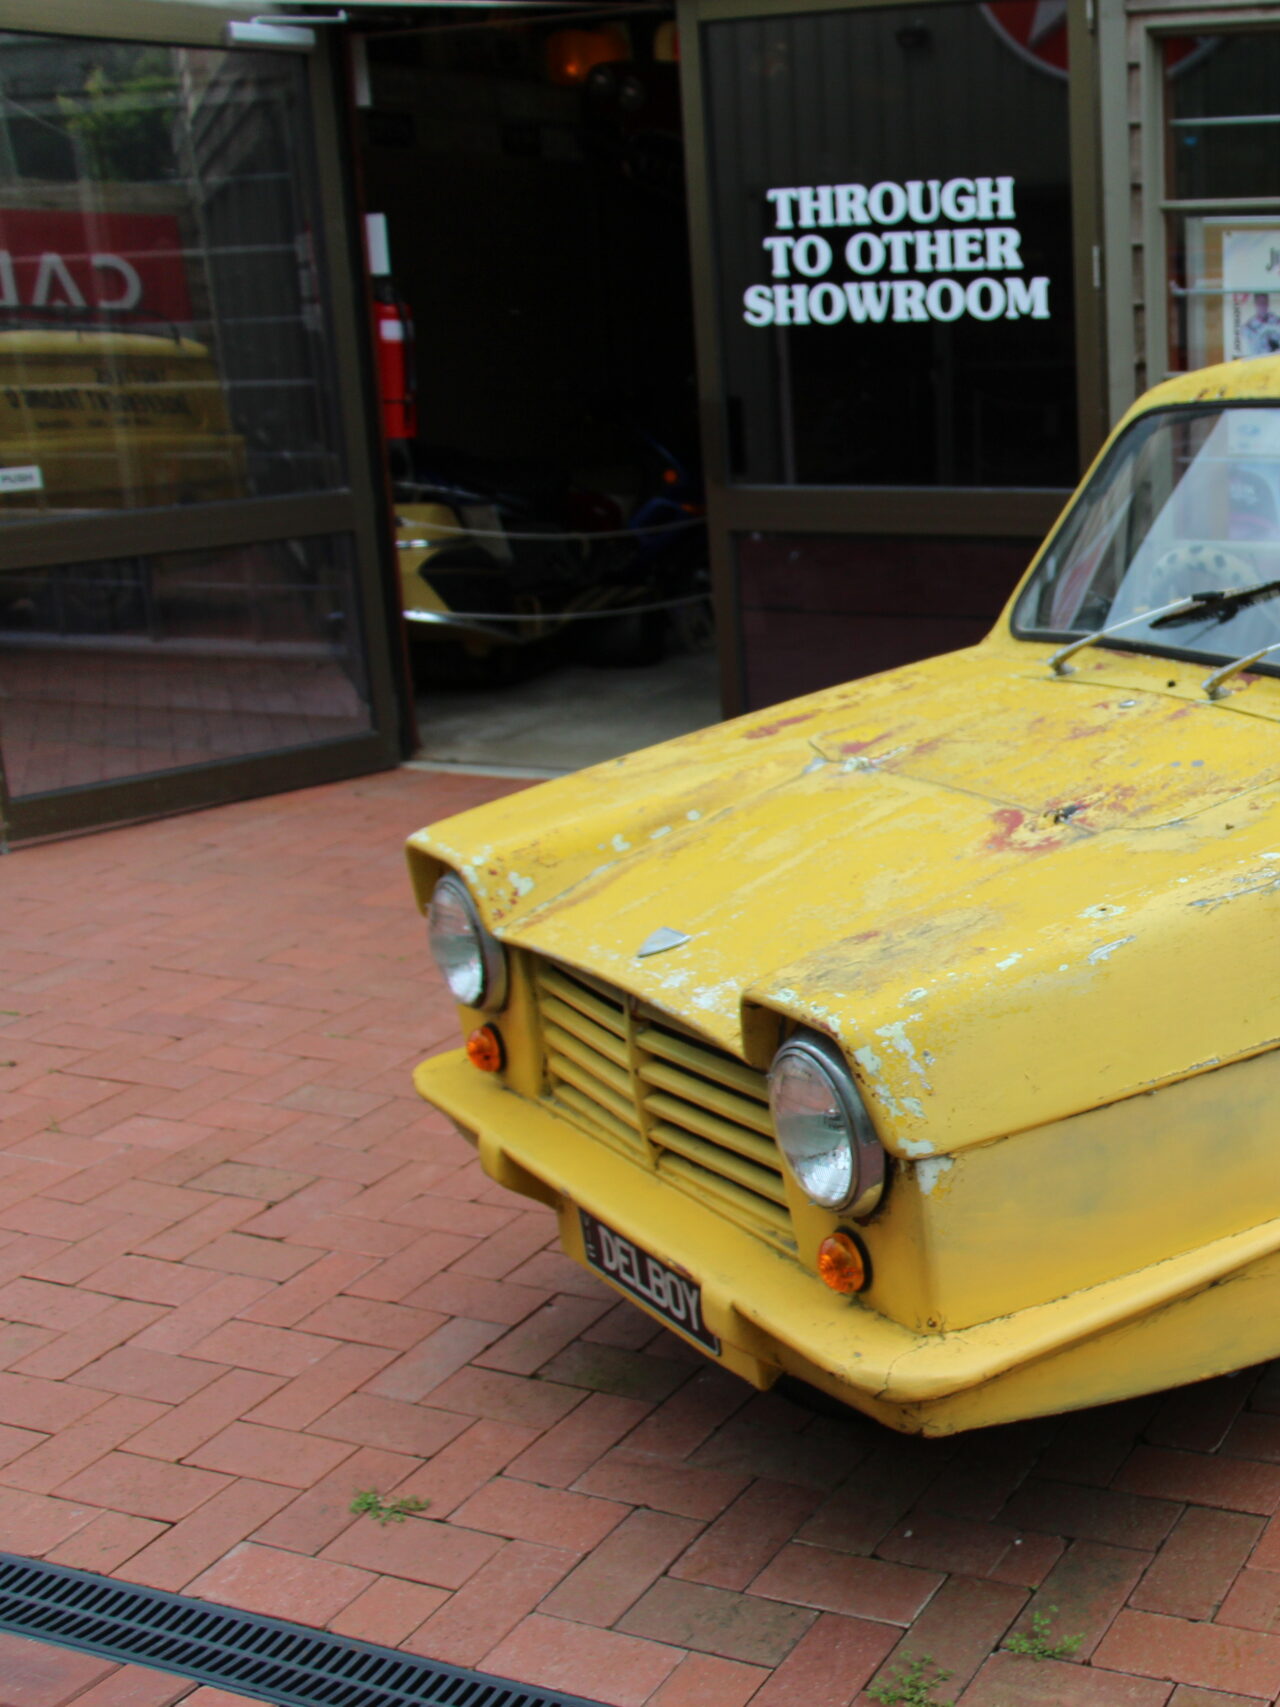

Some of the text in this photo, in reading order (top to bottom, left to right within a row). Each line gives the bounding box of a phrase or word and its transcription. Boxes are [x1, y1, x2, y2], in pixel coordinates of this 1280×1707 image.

[766, 176, 1016, 230] THROUGH
[762, 226, 1025, 278] TO OTHER
[743, 276, 1051, 327] SHOWROOM
[598, 1224, 699, 1331] DELBOY
